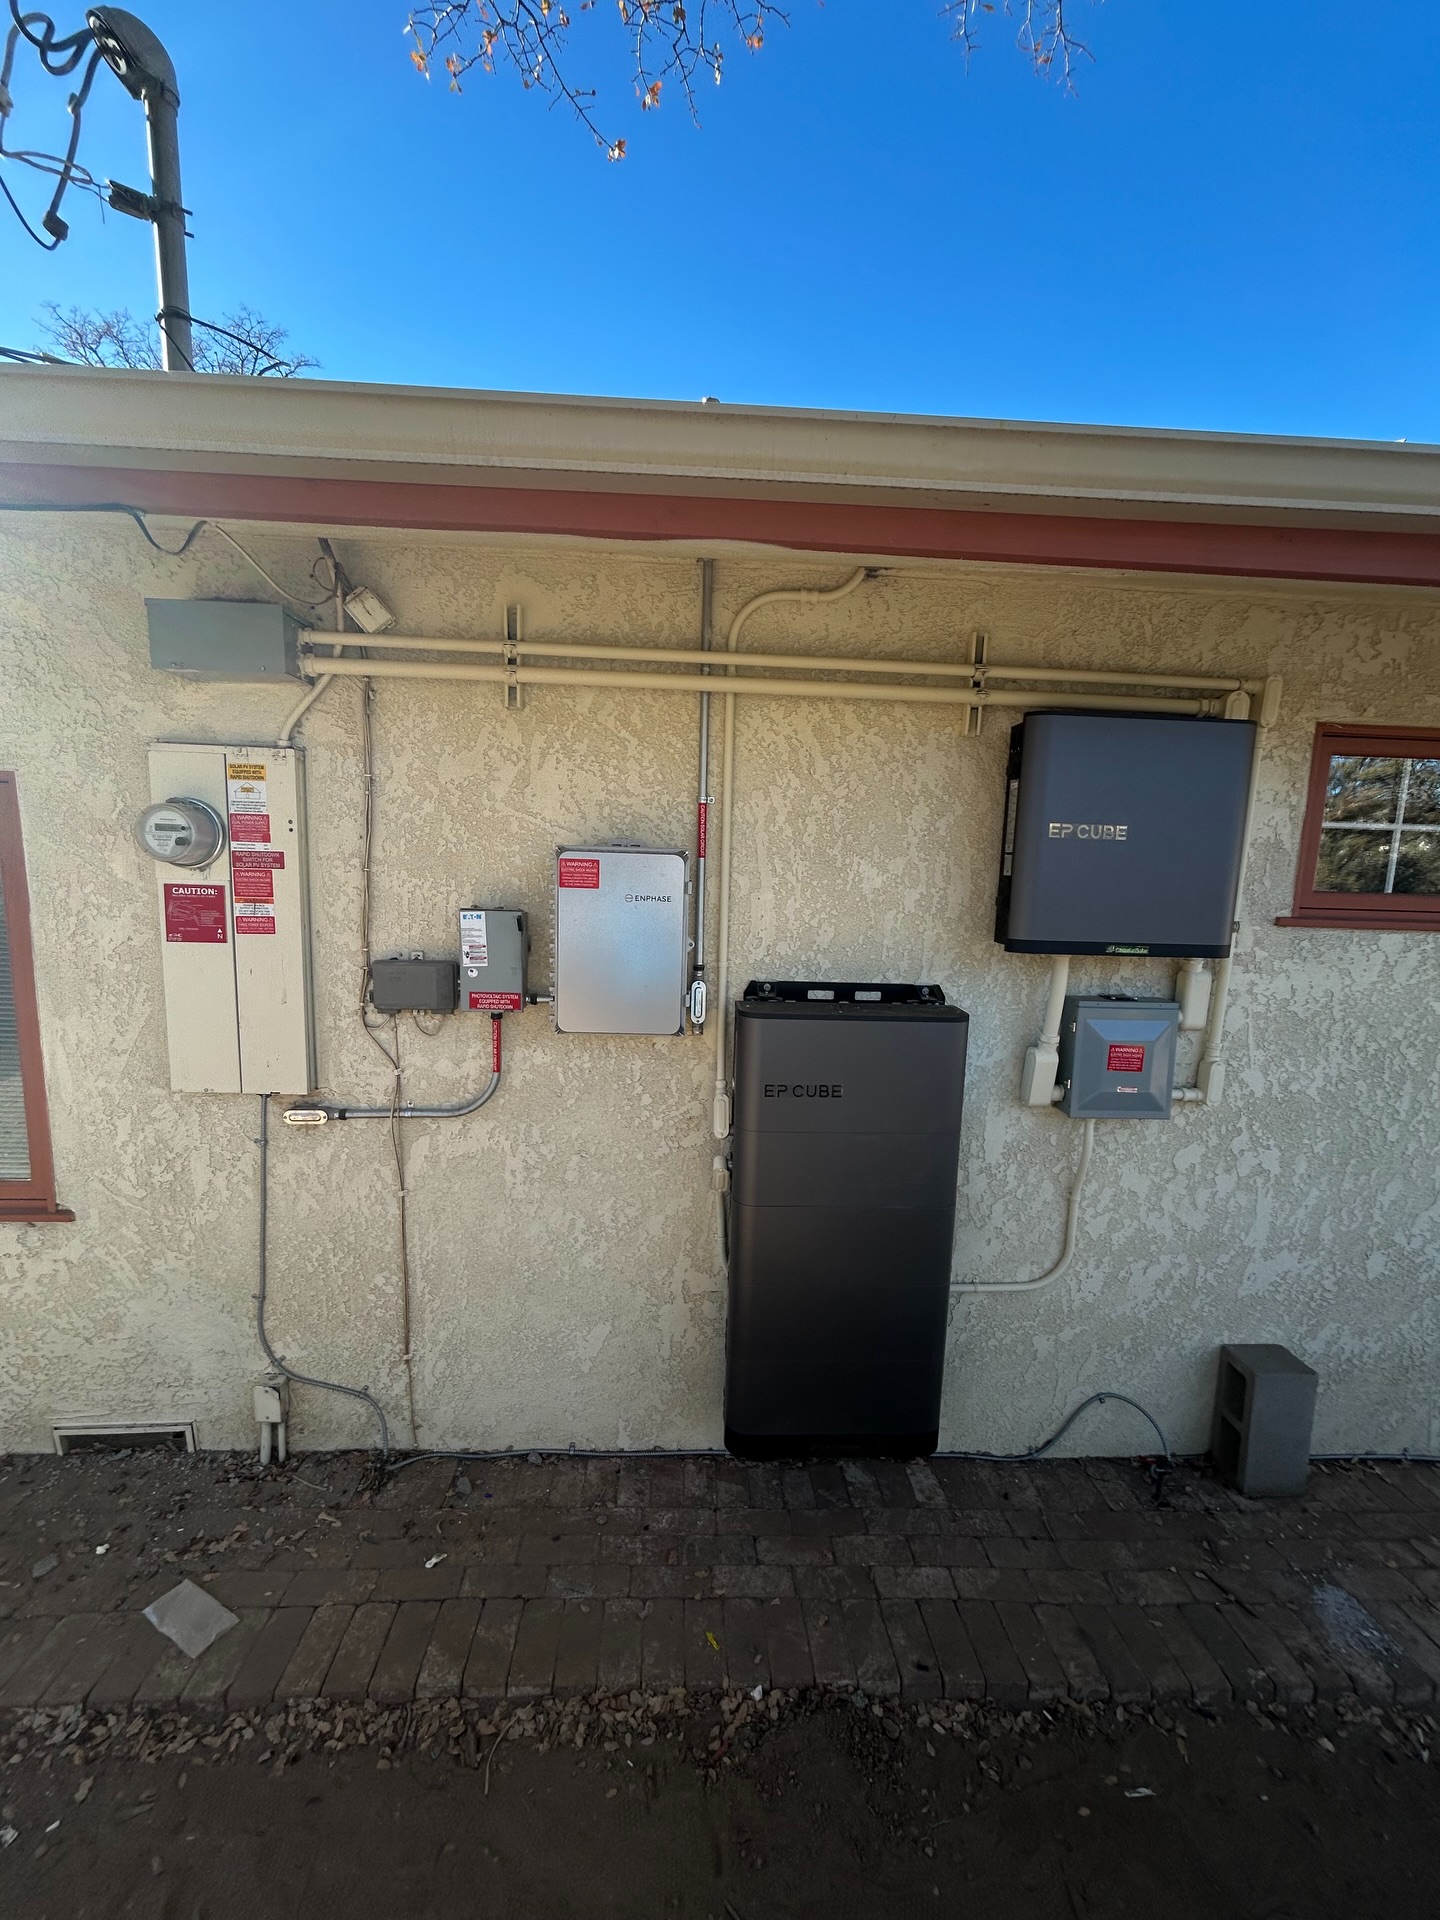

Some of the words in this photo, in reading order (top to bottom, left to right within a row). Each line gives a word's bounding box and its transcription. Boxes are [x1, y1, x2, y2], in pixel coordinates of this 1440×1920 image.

[1048, 822, 1073, 838] EP
[1077, 824, 1128, 840] CUBE
[764, 1084, 788, 1098] EP
[792, 1084, 842, 1098] CUBE
